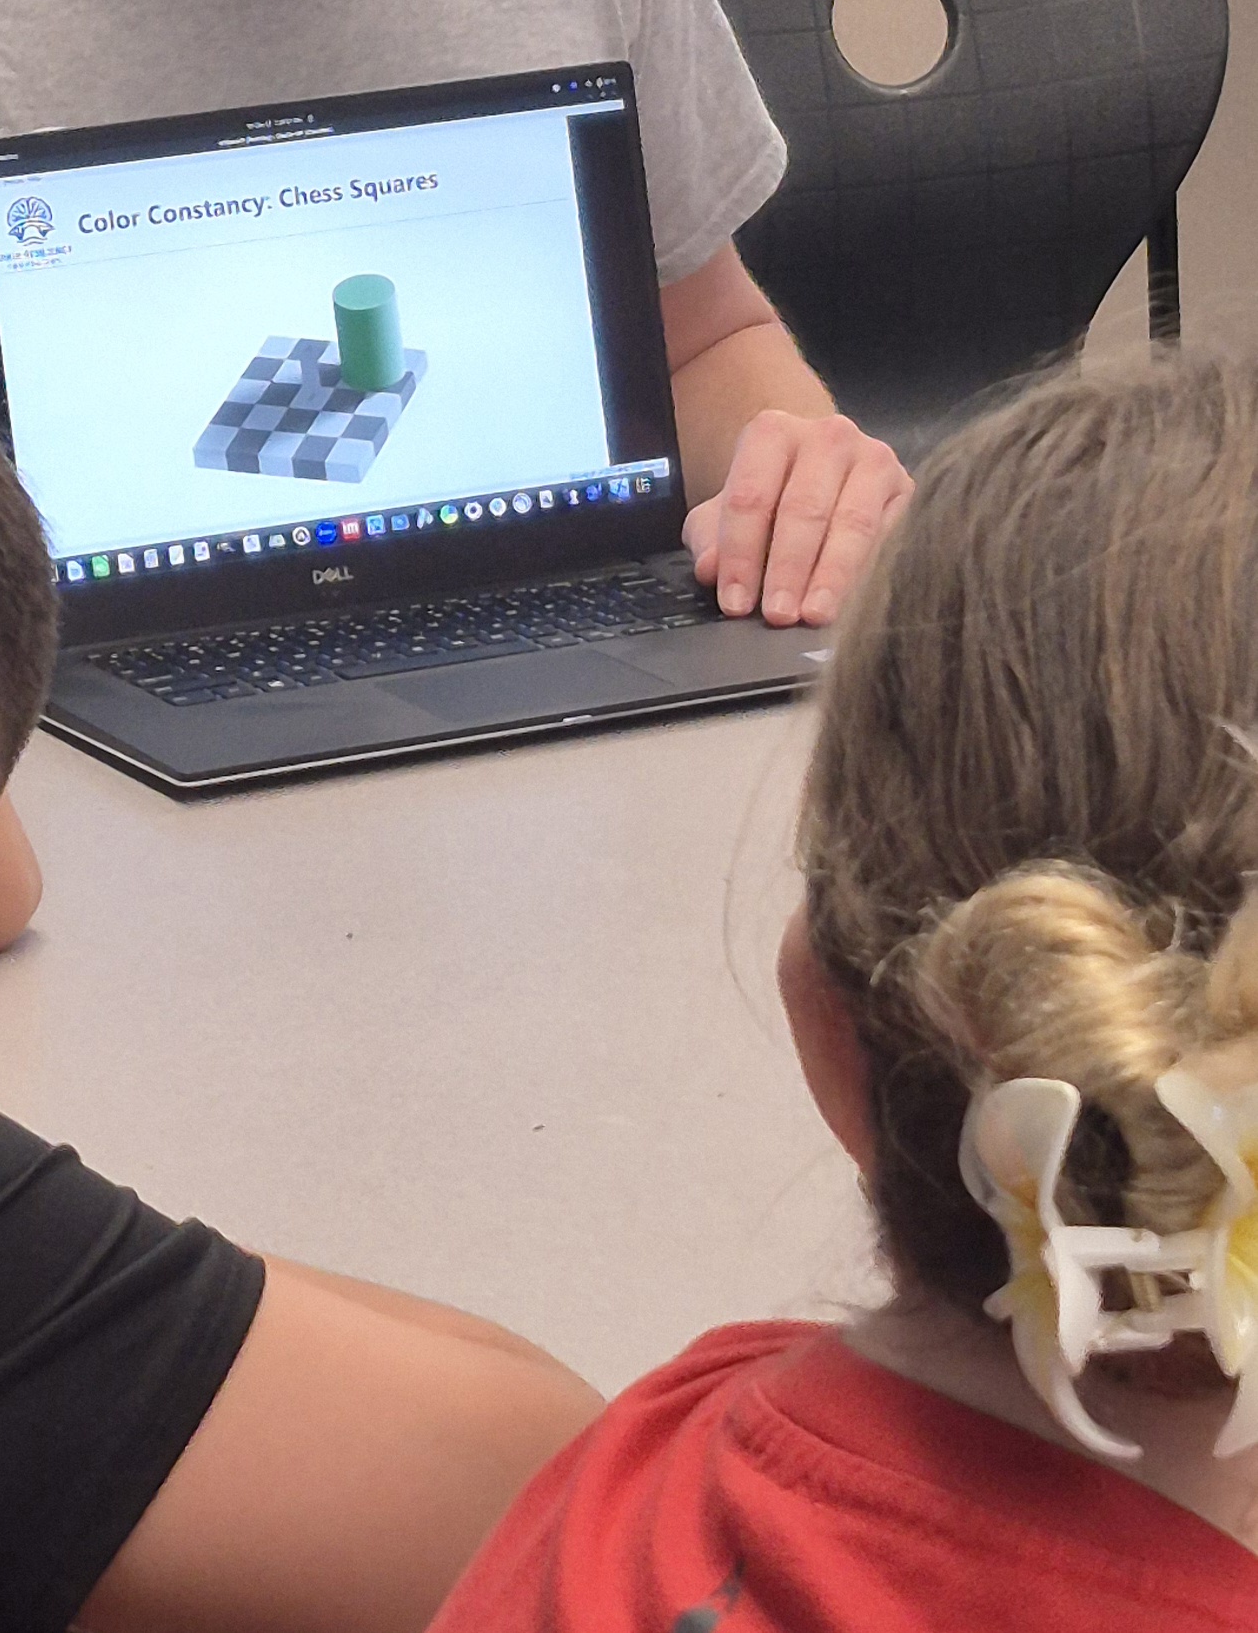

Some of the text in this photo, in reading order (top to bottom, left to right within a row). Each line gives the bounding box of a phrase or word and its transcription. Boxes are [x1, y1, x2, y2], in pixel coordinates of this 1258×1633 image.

[78, 172, 438, 234] Color Constancy: Chess Squares
[312, 566, 354, 585] DELL
